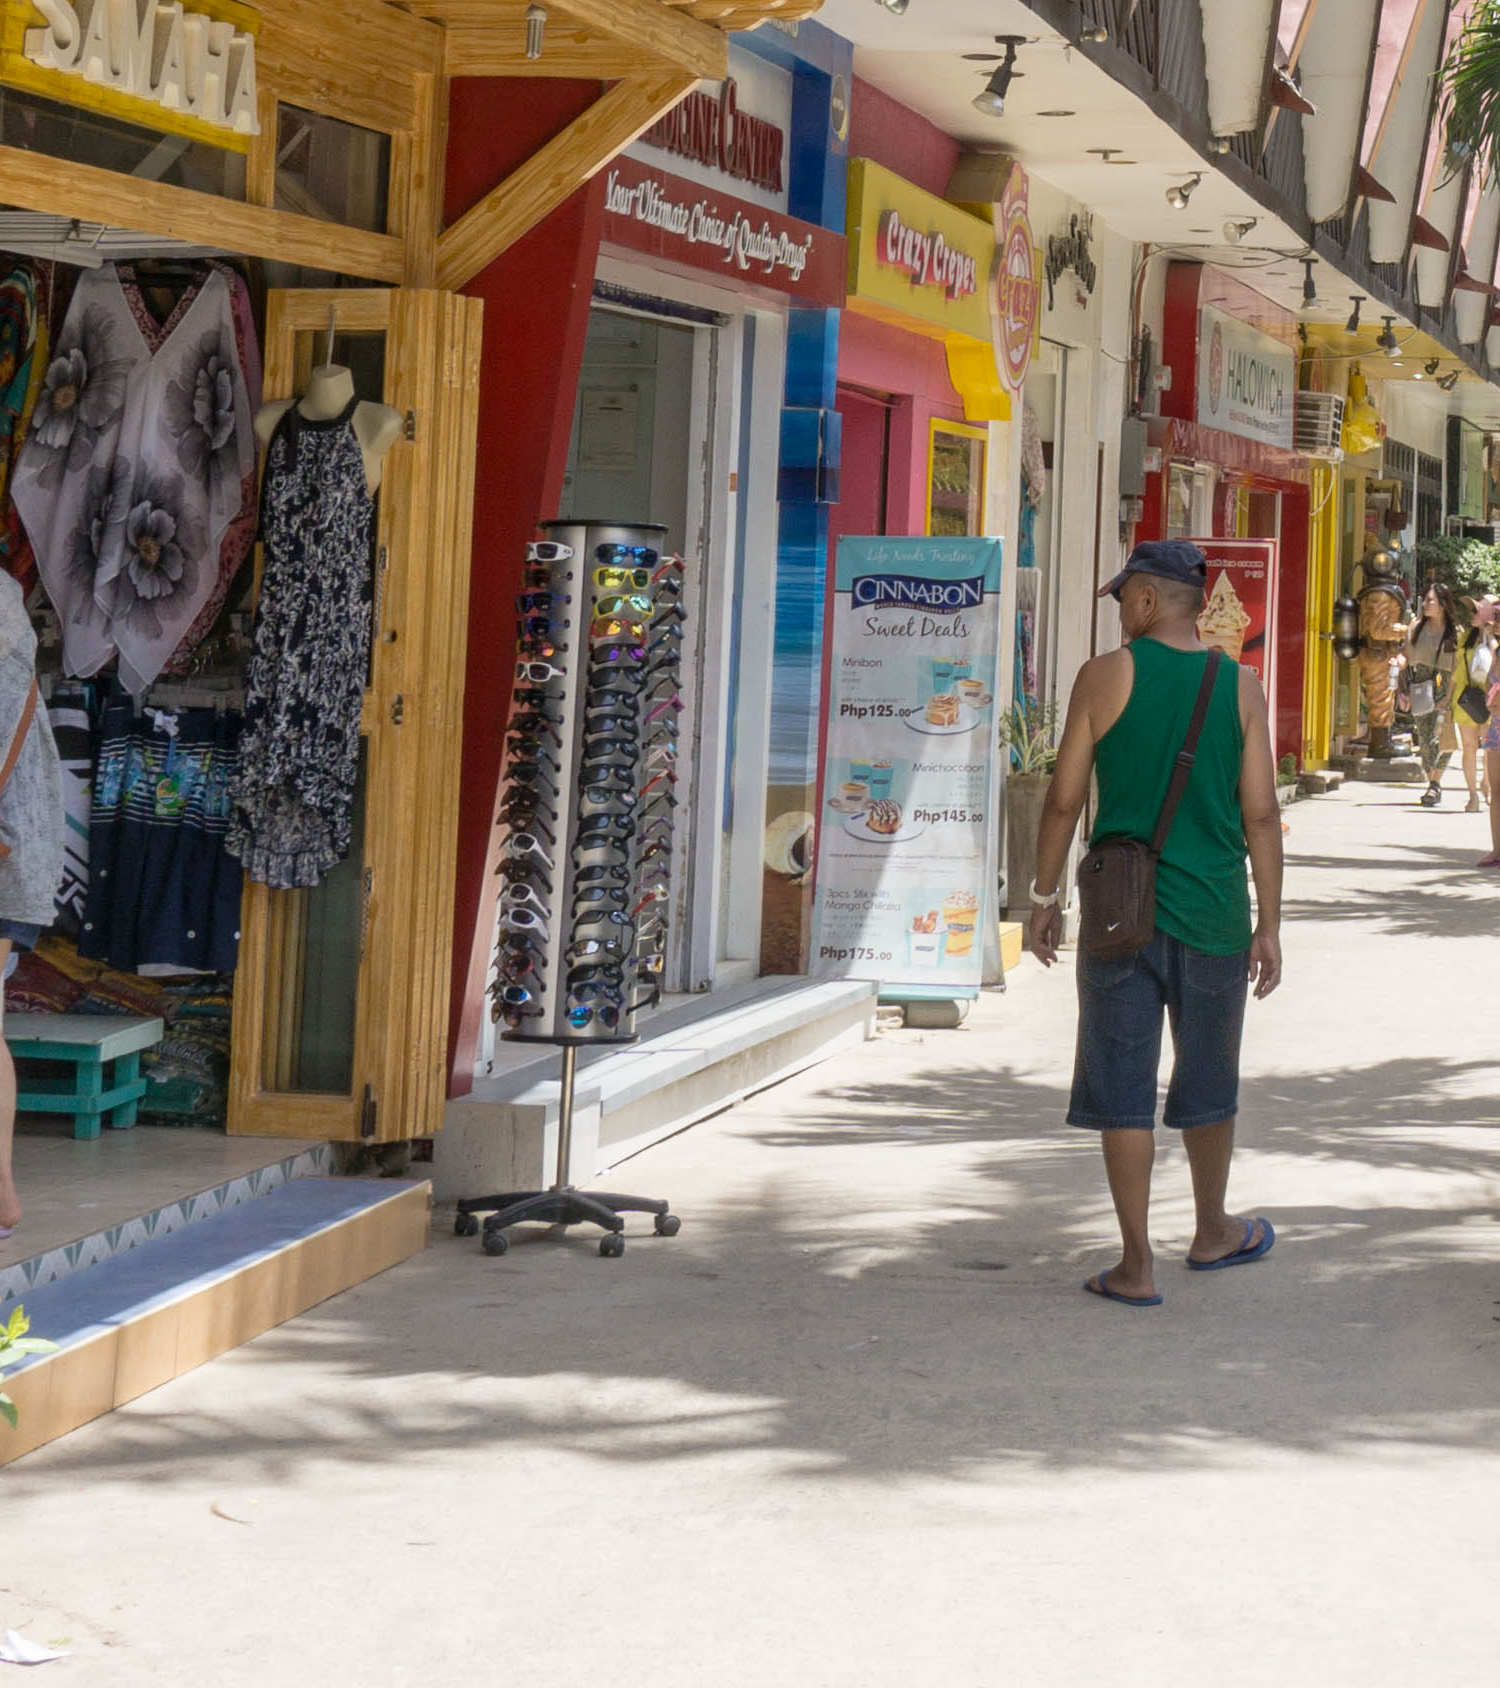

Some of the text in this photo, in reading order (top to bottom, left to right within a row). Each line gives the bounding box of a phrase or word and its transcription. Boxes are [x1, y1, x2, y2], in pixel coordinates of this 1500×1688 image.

[718, 76, 784, 194] CENTER
[603, 168, 635, 216] Your
[634, 178, 690, 235] Ultimate
[687, 199, 725, 246] Choice
[723, 210, 742, 263] of
[736, 218, 778, 275] Quality
[883, 210, 932, 285] Crazy
[931, 231, 977, 300] Crepes
[855, 577, 983, 606] CINNABON
[862, 615, 971, 638] Sweet Deals
[842, 657, 883, 669] Minibon
[839, 704, 911, 720] Php125.00
[913, 809, 984, 824] Php145.00
[819, 946, 892, 962] Php175.00
